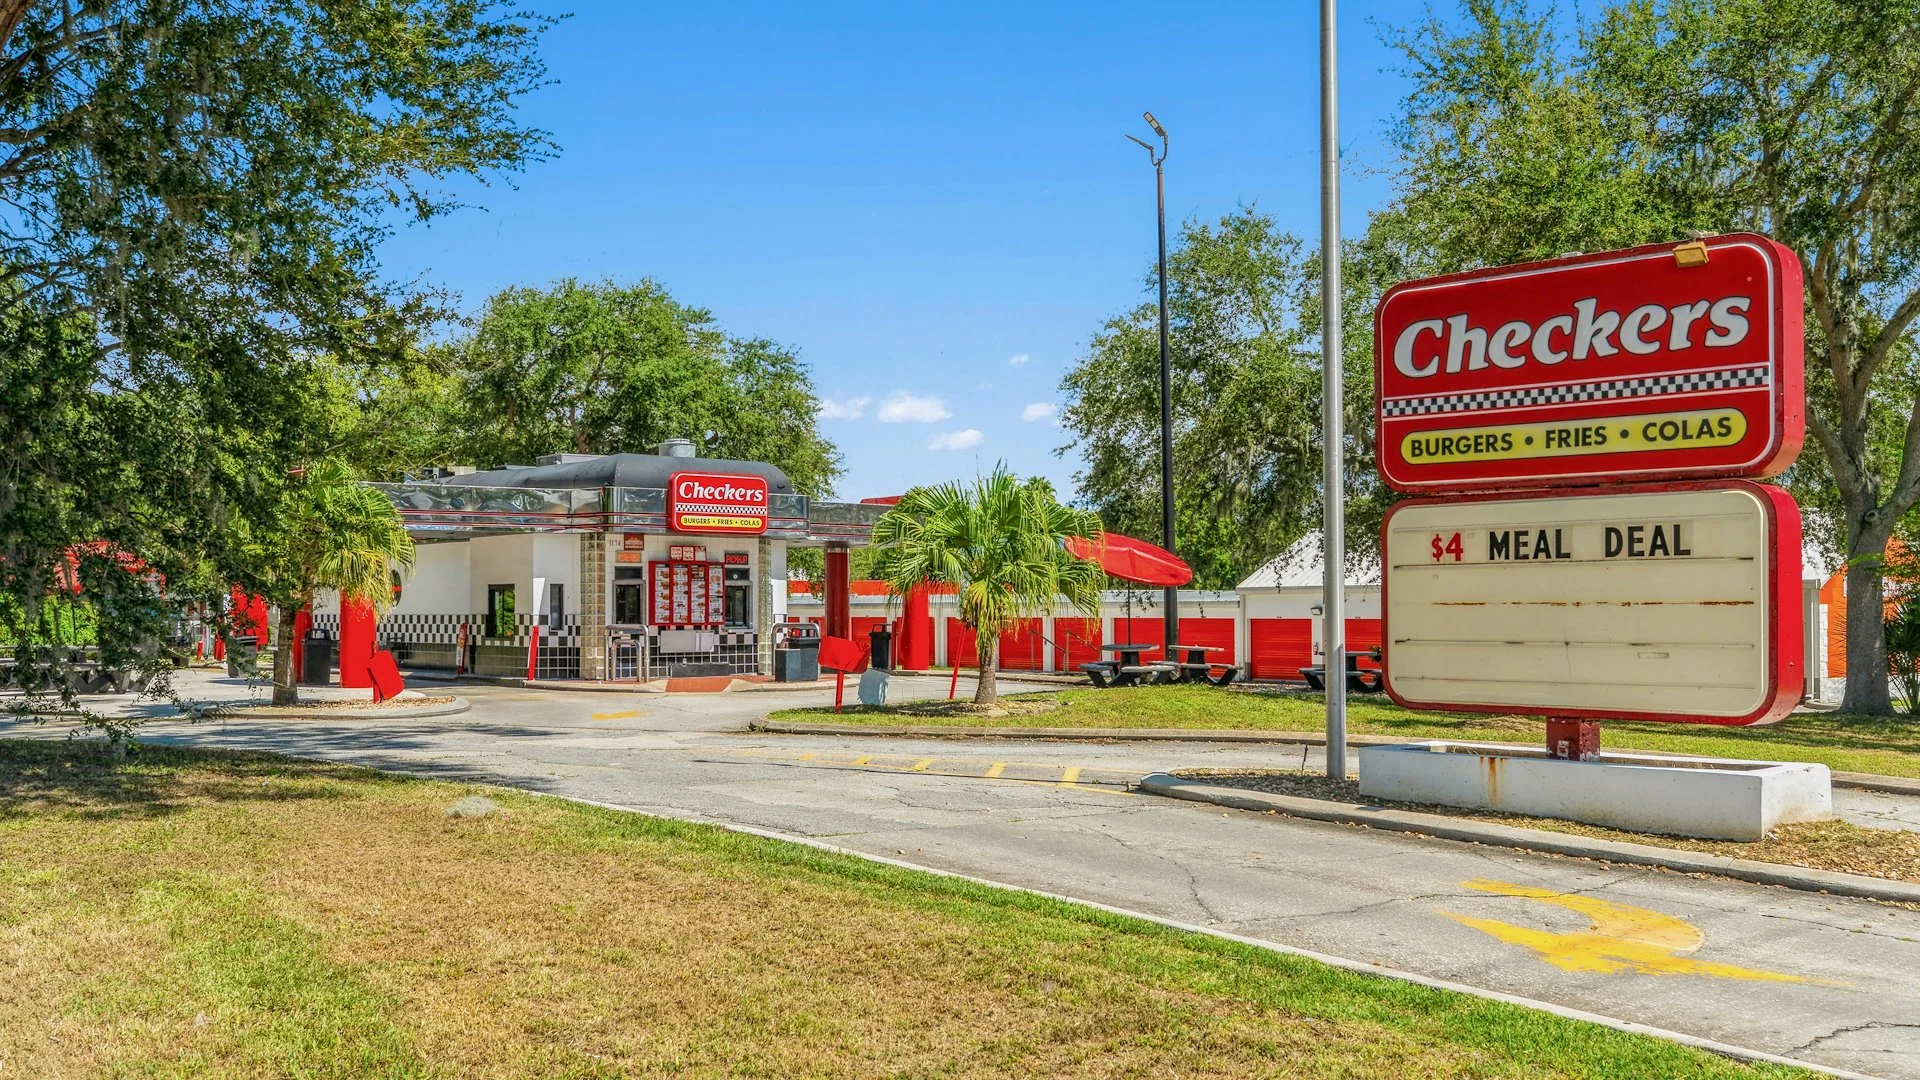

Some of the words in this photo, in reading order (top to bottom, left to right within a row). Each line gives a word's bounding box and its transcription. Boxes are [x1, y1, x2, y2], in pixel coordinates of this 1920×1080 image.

[1393, 296, 1752, 378] Checkers
[1410, 432, 1513, 457] BURGERS
[1544, 425, 1608, 449] FRIES
[1641, 416, 1732, 442] COLAS
[679, 481, 764, 502] Checkers
[1430, 531, 1464, 562] $4
[1488, 528, 1572, 561] MEAL
[1604, 524, 1691, 558] DEAL
